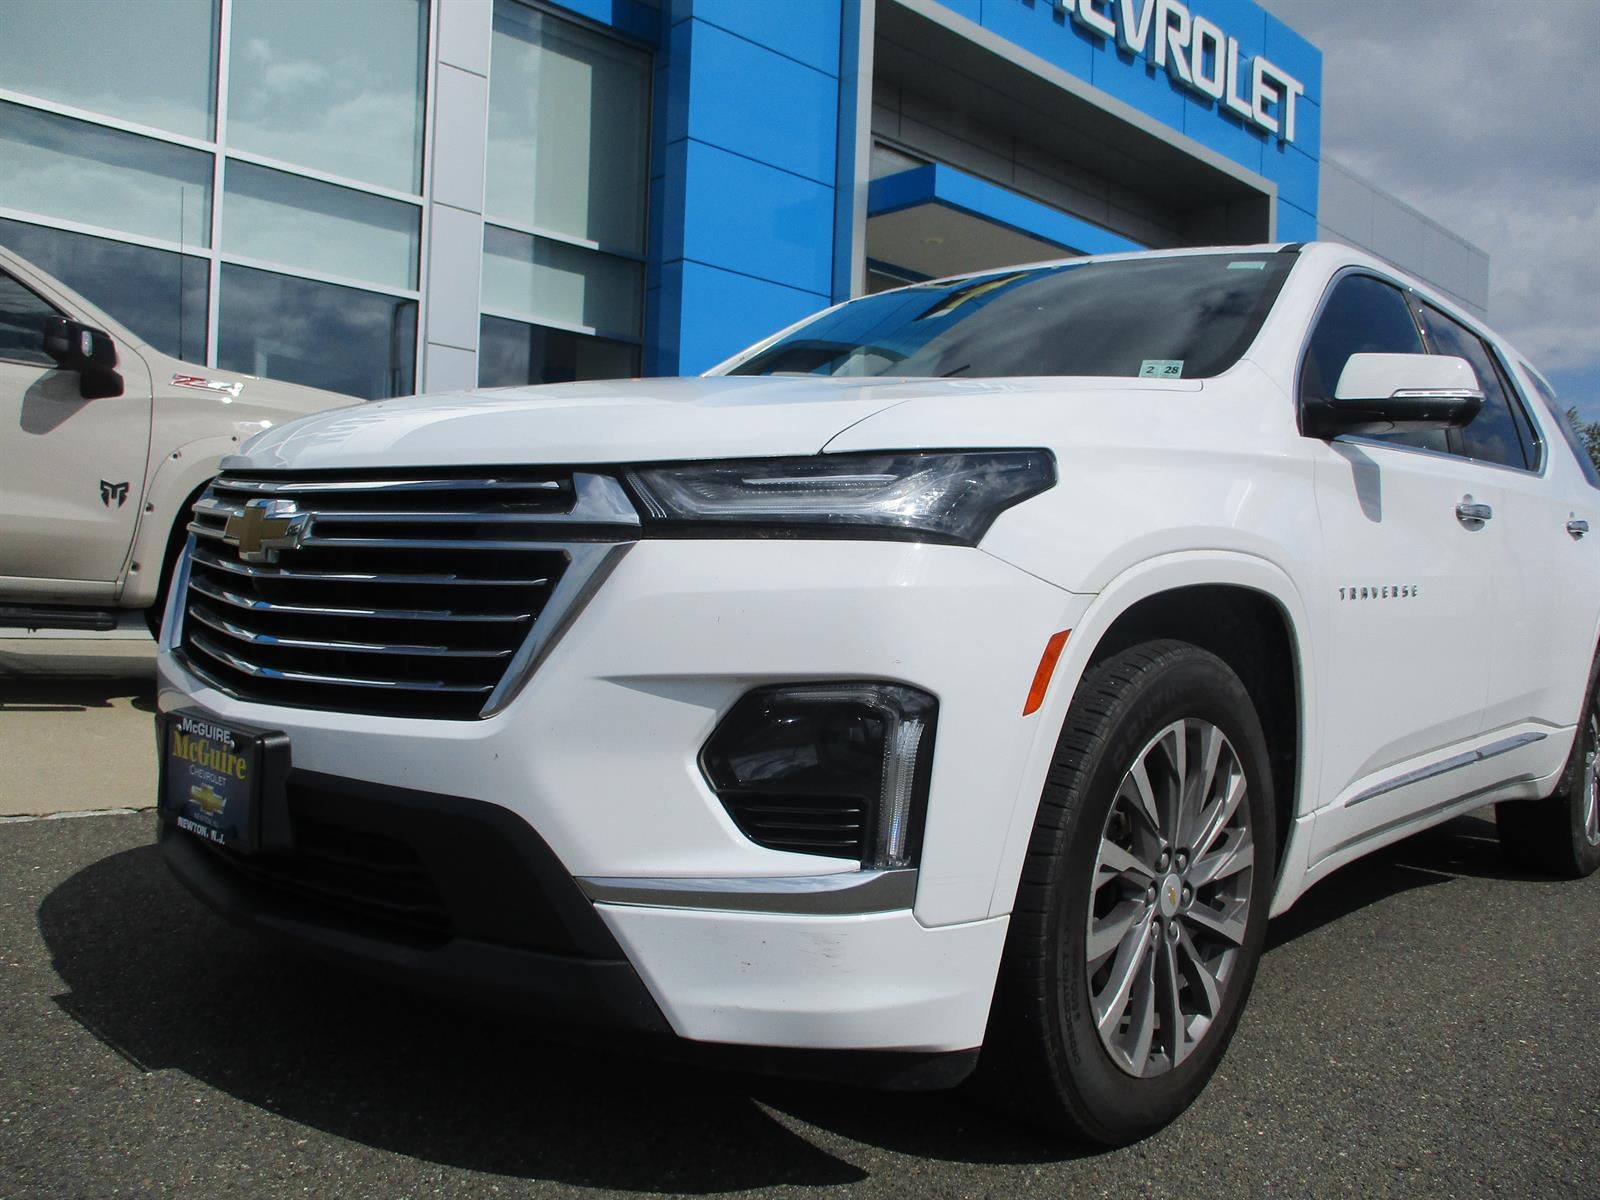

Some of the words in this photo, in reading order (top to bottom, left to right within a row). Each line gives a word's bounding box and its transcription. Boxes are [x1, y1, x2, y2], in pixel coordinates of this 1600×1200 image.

[1062, 0, 1304, 142] VROLET
[1146, 366, 1155, 374] 2
[1164, 366, 1180, 375] 28
[1338, 585, 1419, 601] TRAVERSE
[182, 718, 232, 744] McGUIRE
[173, 731, 248, 779] McGuire
